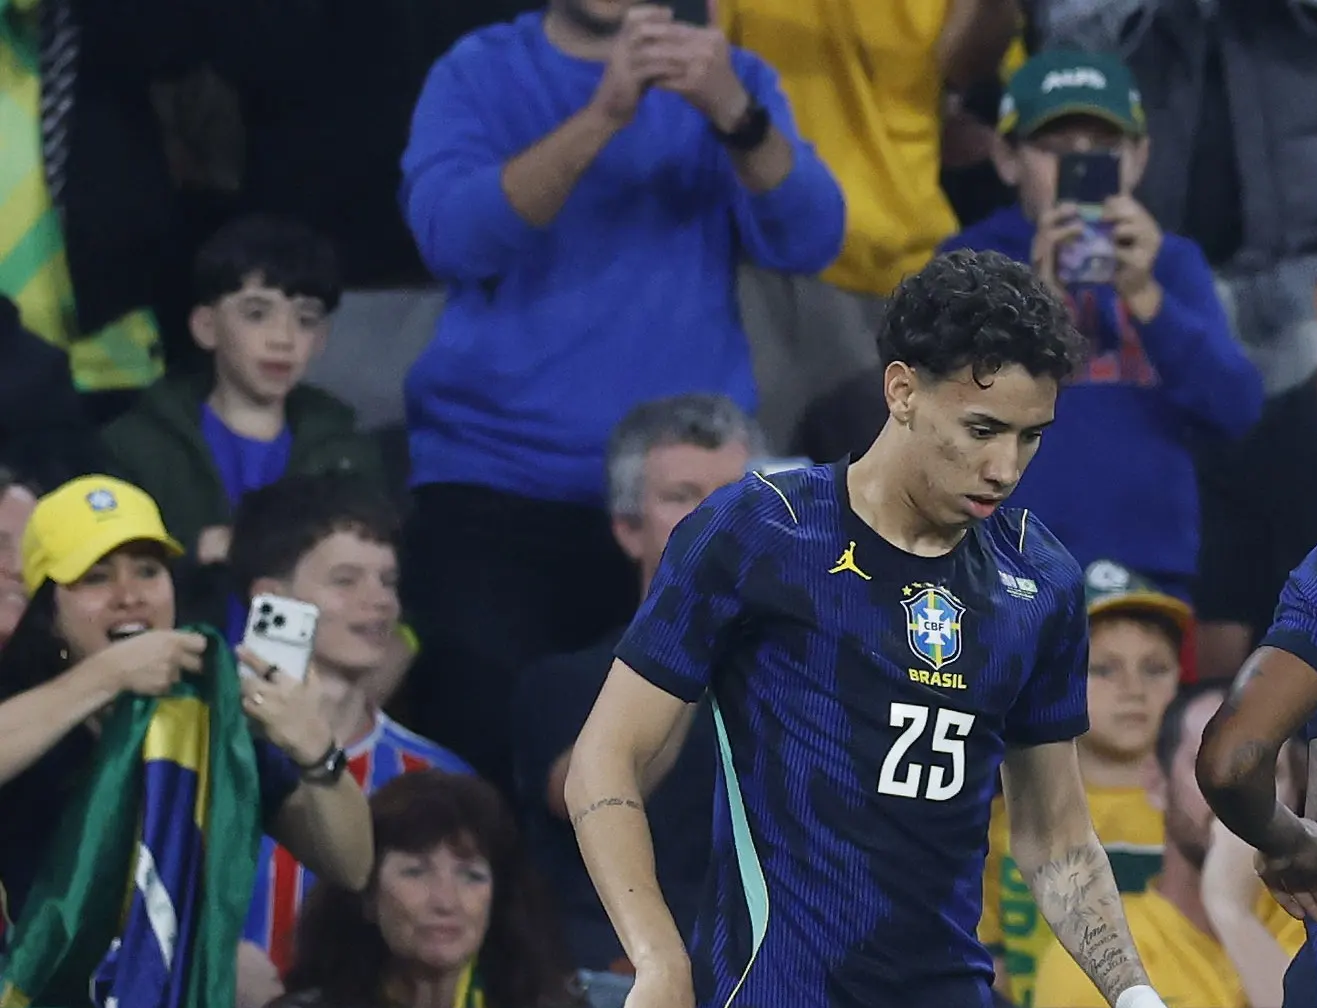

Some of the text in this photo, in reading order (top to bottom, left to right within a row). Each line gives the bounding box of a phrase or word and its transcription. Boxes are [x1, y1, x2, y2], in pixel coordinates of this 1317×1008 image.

[924, 621, 945, 632] CBF
[908, 668, 968, 689] BRASIL
[877, 702, 976, 801] 25
